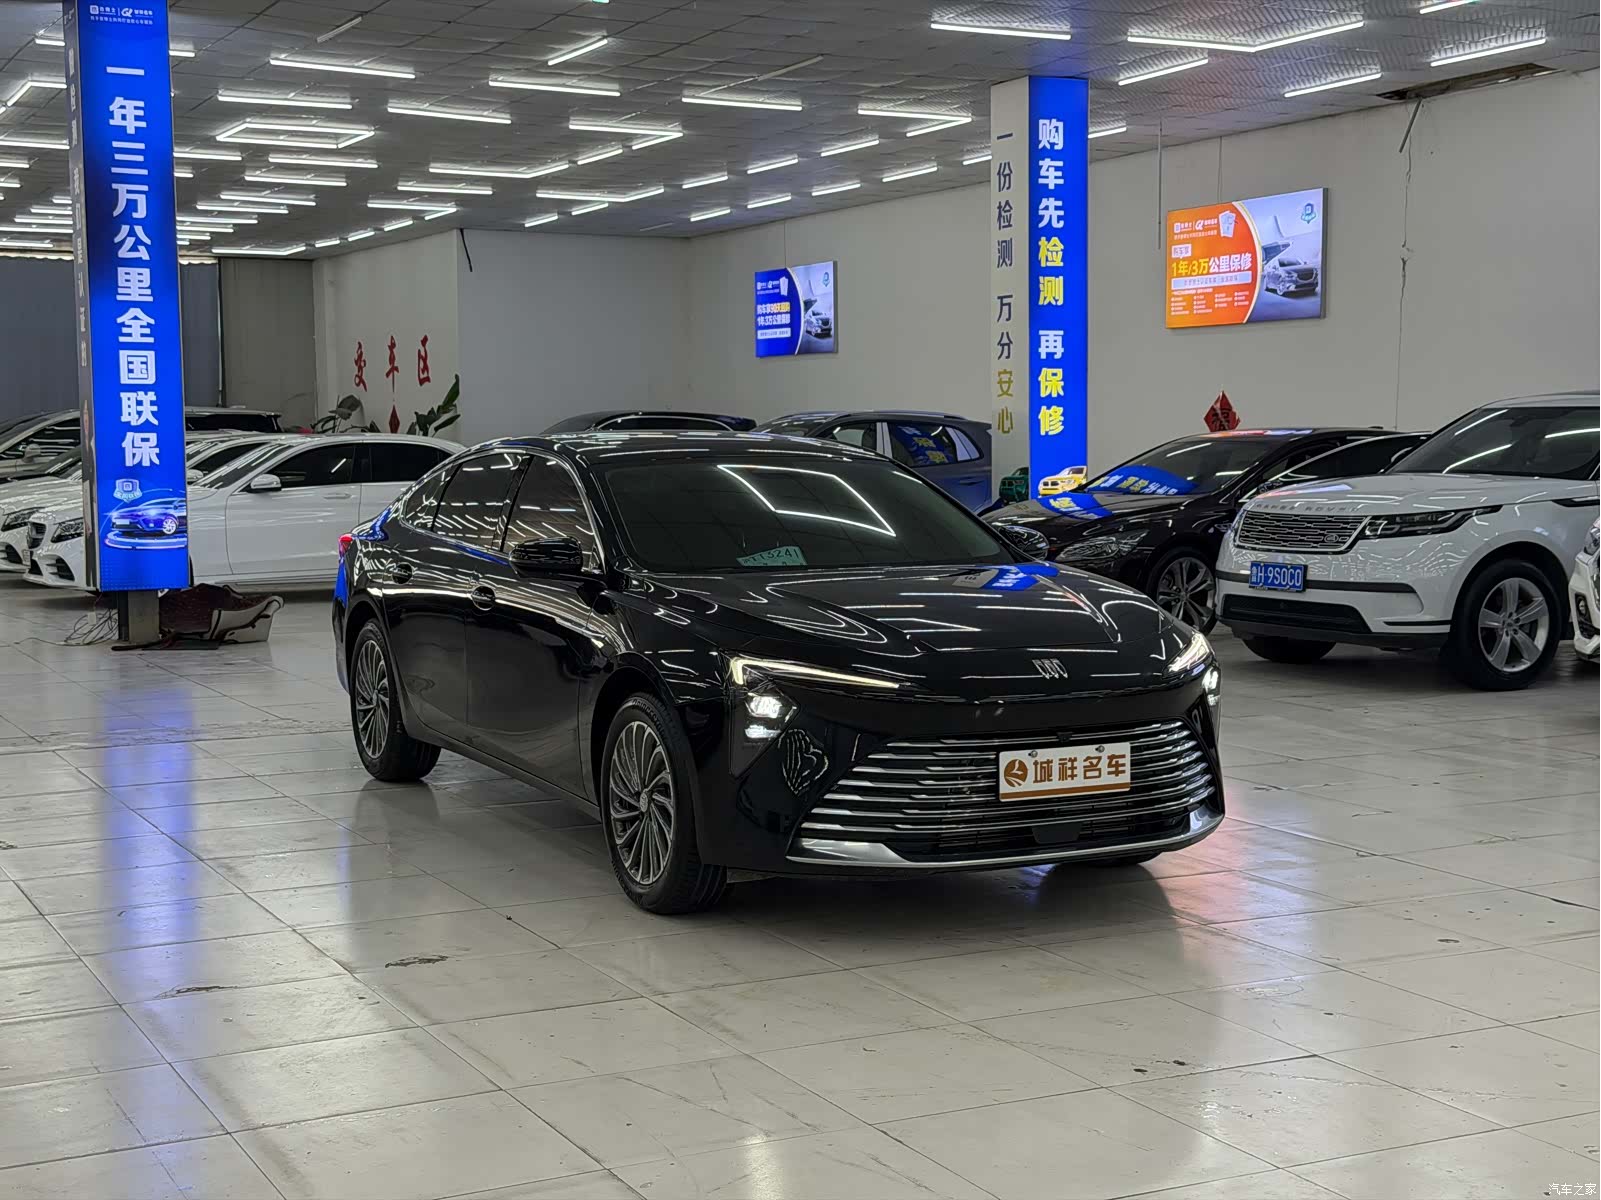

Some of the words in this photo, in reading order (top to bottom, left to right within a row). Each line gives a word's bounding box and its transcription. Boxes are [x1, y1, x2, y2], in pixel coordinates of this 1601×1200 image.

[106, 65, 161, 467] 一年三万公里全国联保
[996, 132, 1014, 269] 一份检测
[1038, 118, 1065, 307] 购车先检测
[1171, 252, 1253, 277] 1年/3万公里保修
[996, 294, 1014, 435] 万分安心
[1038, 329, 1065, 437] 再保修
[1033, 754, 1127, 784] 城祥名车
